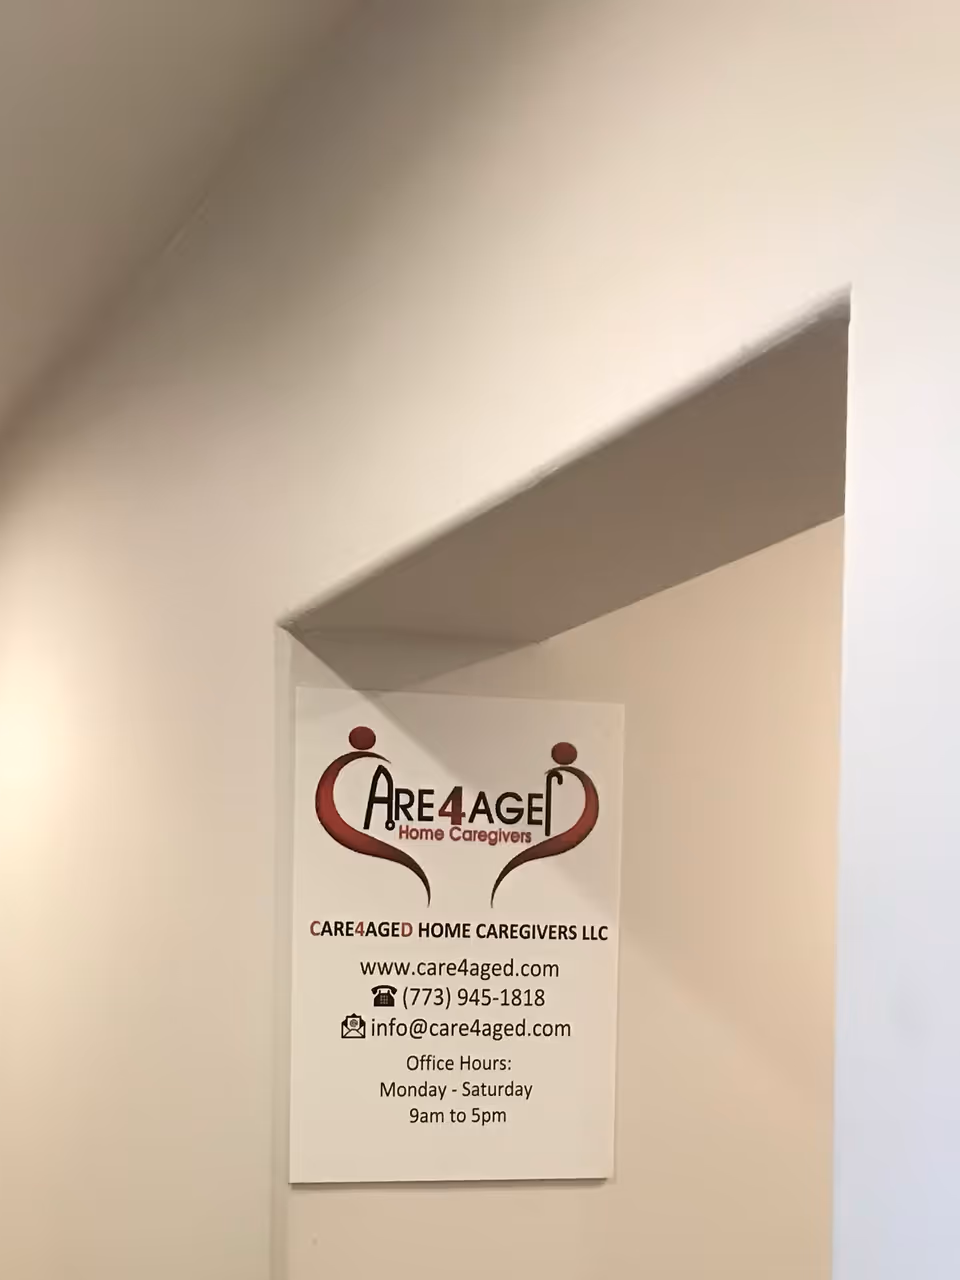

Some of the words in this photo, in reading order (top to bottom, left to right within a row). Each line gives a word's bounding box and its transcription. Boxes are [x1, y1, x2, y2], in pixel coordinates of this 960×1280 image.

[399, 825, 444, 841] Home
[450, 827, 532, 845] Caregivers
[310, 921, 413, 937] CARE4AGED
[418, 923, 471, 938] HOME
[476, 923, 577, 940] CAREGIVERS
[582, 925, 608, 940] LLC
[360, 959, 559, 980] www.care4aged.com
[402, 987, 451, 1010] (773)
[457, 988, 545, 1006] 945-1818
[371, 1019, 571, 1040] info@care4aged.com
[406, 1055, 454, 1071] Office
[460, 1055, 512, 1071] Hours:
[380, 1082, 447, 1100] Monday
[462, 1081, 533, 1100] Saturday
[409, 1109, 445, 1123] 9am
[450, 1109, 466, 1123] to
[472, 1109, 507, 1126] 5pm
